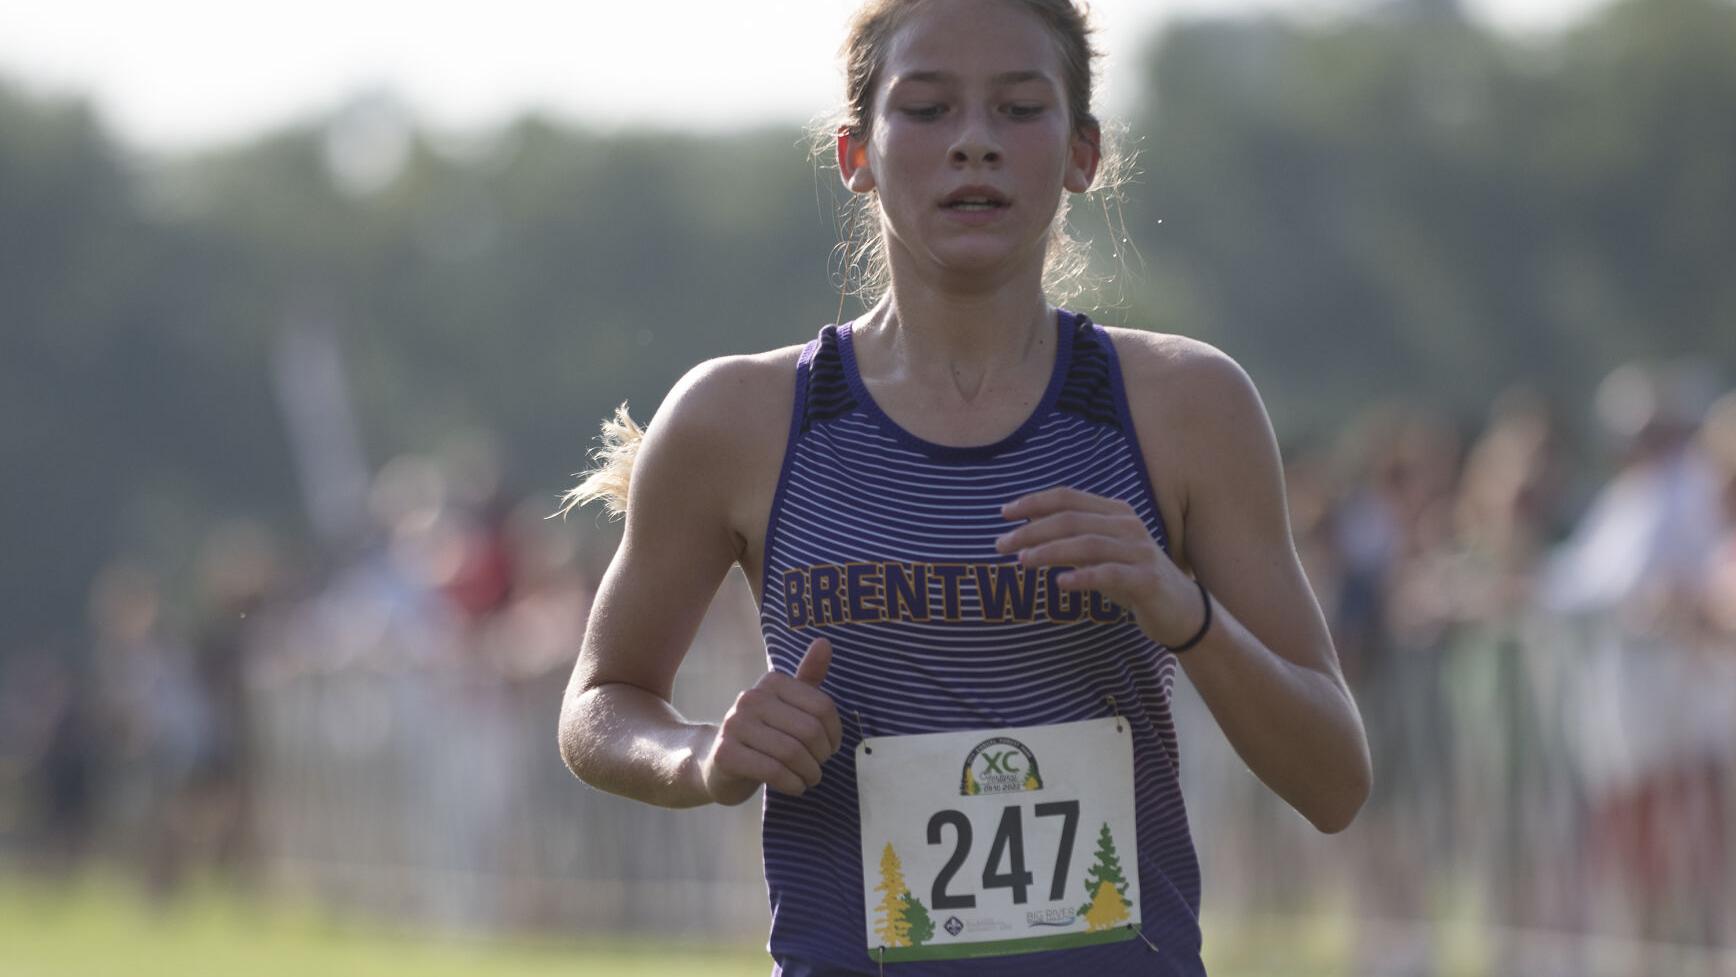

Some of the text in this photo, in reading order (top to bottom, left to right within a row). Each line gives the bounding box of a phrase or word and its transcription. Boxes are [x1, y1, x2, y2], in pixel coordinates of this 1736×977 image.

[783, 562, 1136, 629] BRENTWO
[982, 751, 1019, 774] XC
[926, 800, 1080, 910] 247
